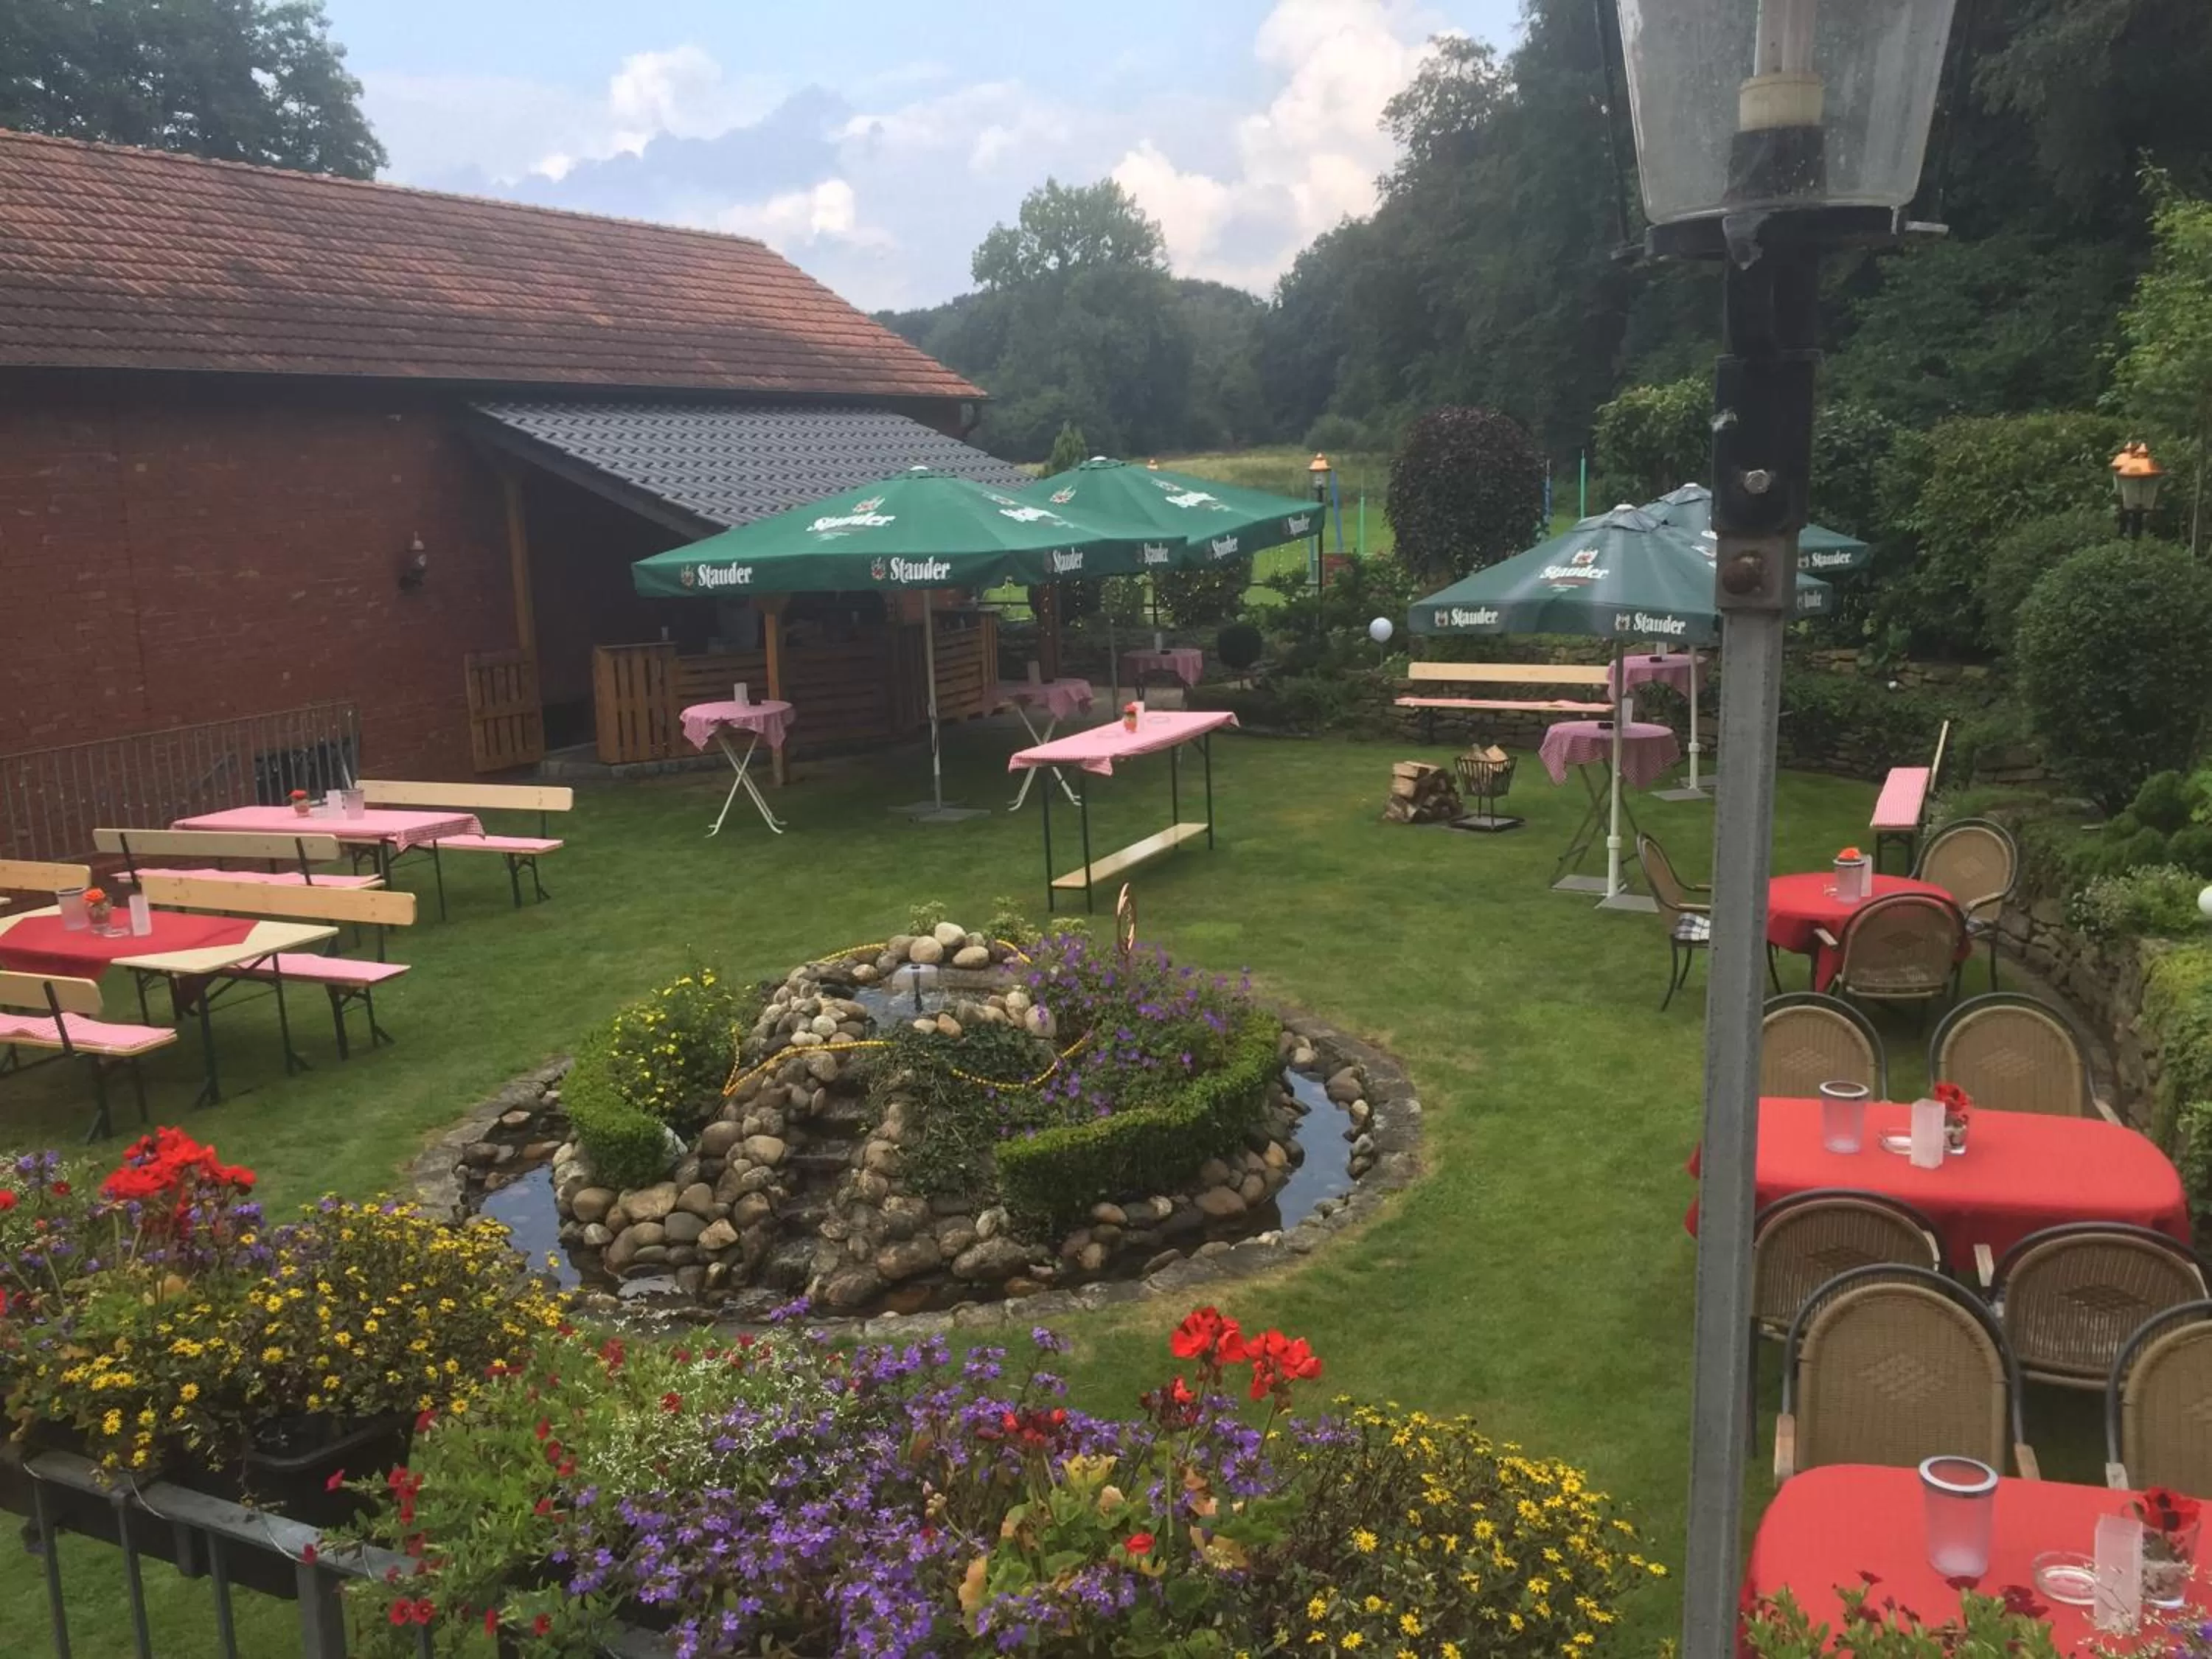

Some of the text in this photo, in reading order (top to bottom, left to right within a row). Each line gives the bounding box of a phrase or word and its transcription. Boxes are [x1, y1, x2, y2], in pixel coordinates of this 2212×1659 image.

[890, 557, 950, 583] Stauder
[1052, 547, 1082, 574] Stauder
[698, 562, 752, 588] Stauder
[1451, 608, 1498, 627] Stauder
[1633, 613, 1686, 635] Stauder
